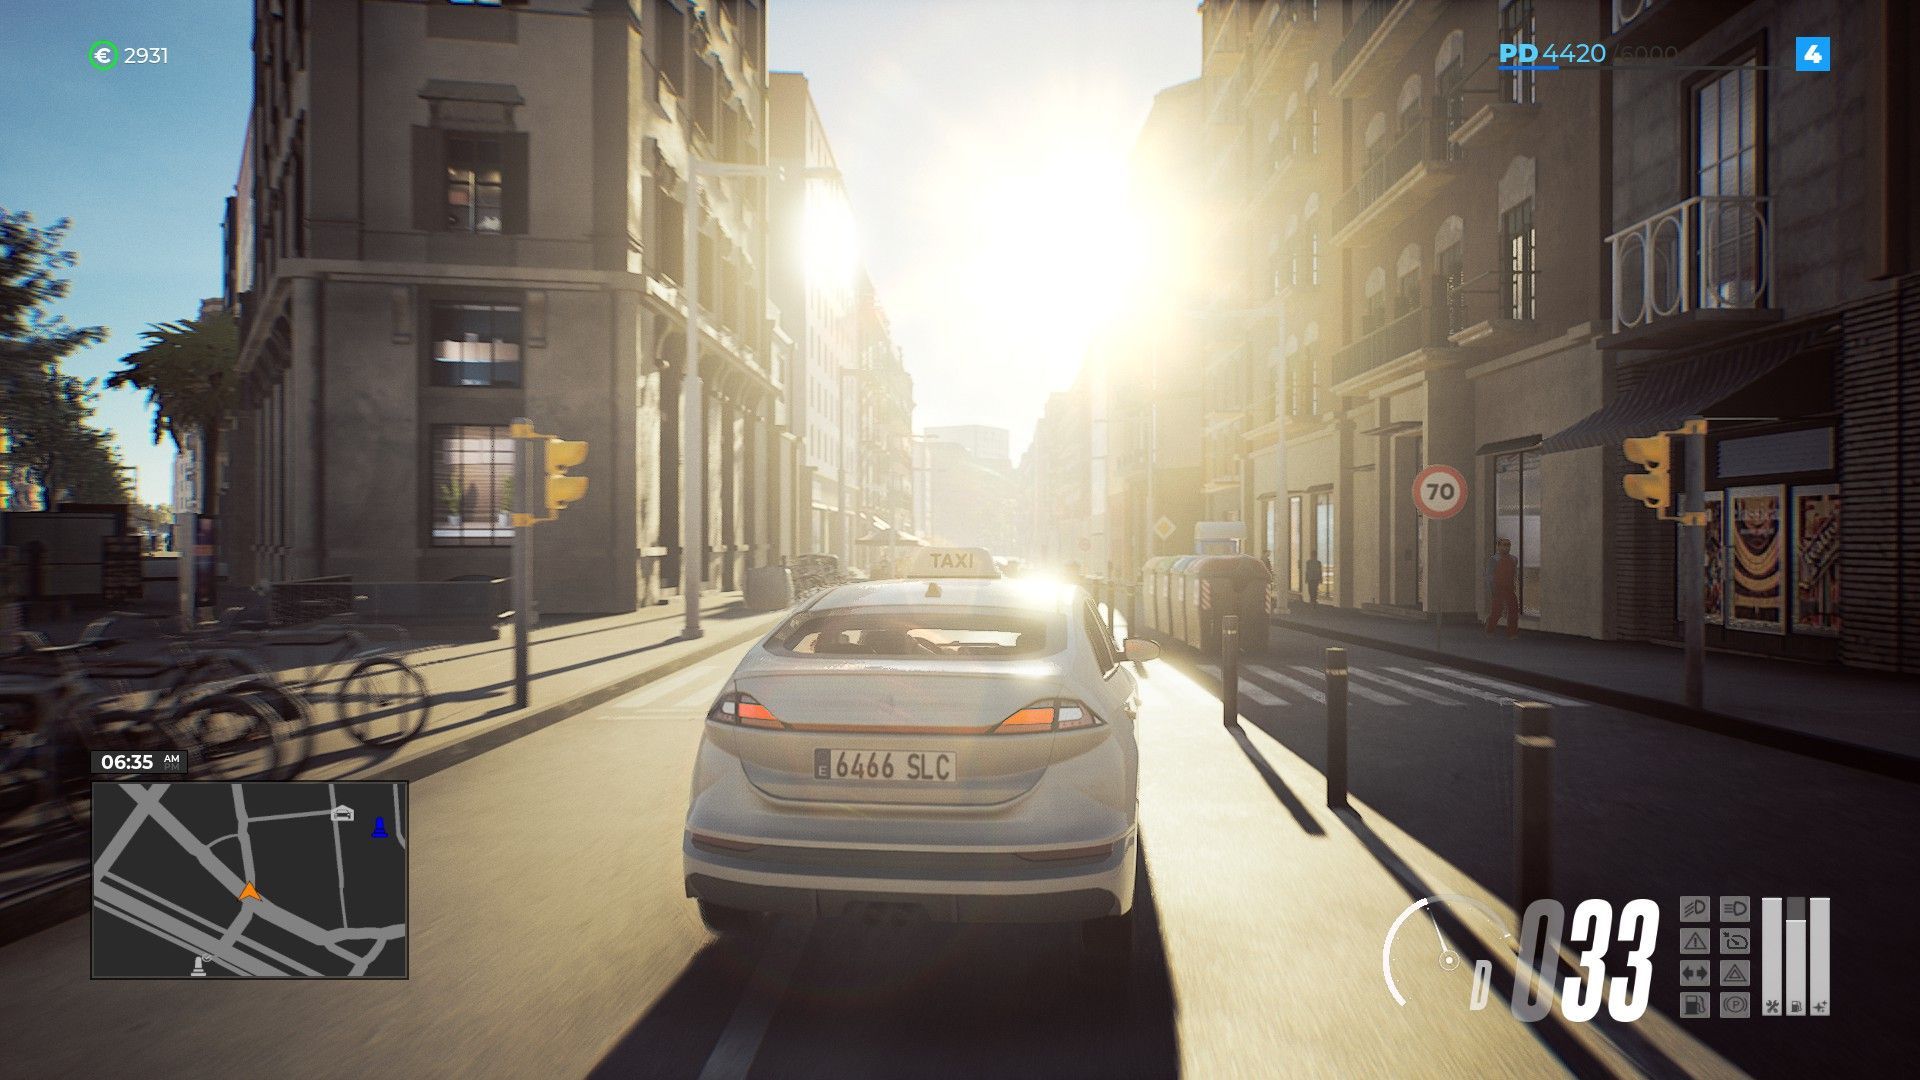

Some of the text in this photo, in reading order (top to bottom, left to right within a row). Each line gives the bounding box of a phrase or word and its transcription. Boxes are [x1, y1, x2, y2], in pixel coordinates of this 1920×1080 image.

[1426, 483, 1455, 501] 70
[929, 552, 974, 569] TAXI
[818, 751, 950, 780] E 6466 SLC
